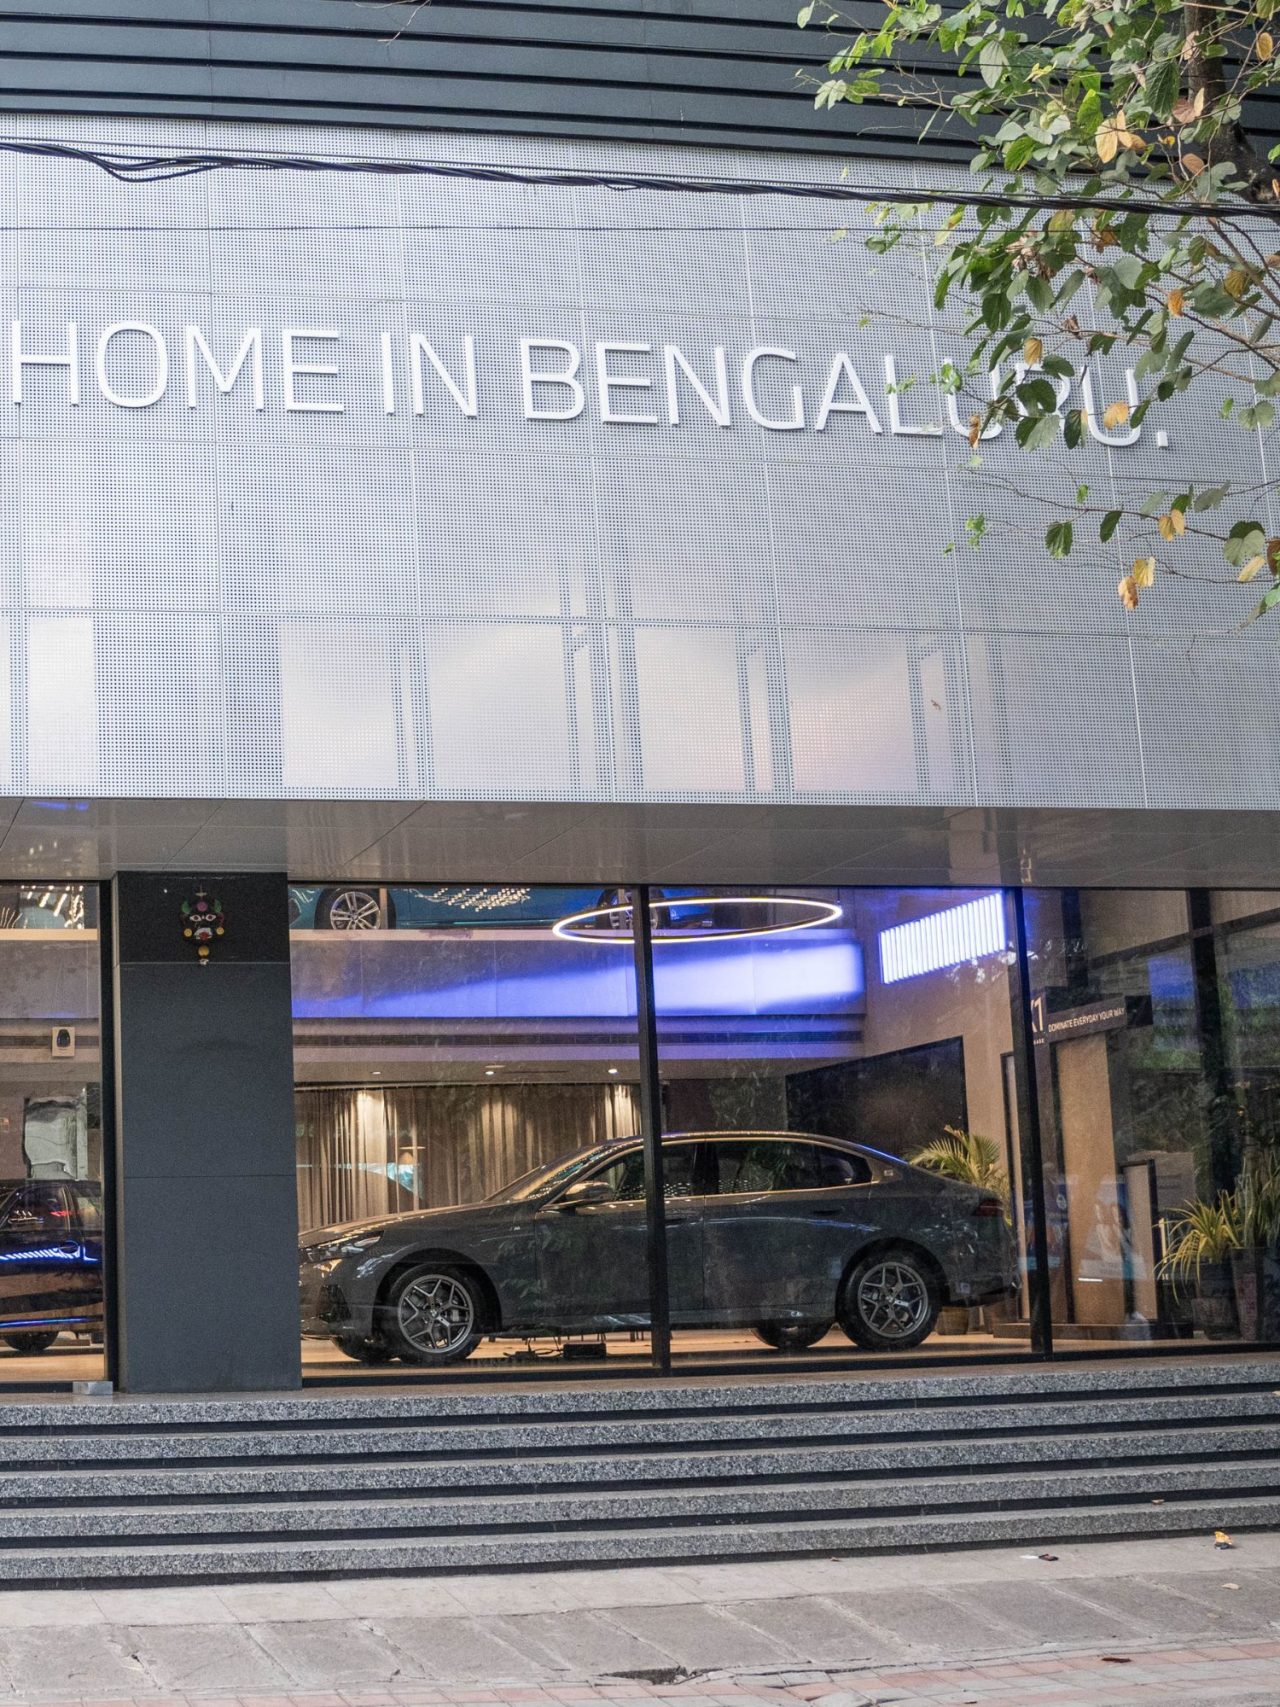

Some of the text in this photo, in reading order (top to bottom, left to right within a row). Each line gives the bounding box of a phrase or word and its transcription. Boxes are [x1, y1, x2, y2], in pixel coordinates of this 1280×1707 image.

[13, 319, 346, 413] HOME
[380, 331, 478, 418] IN
[1073, 1013, 1100, 1027] EVERYDAY
